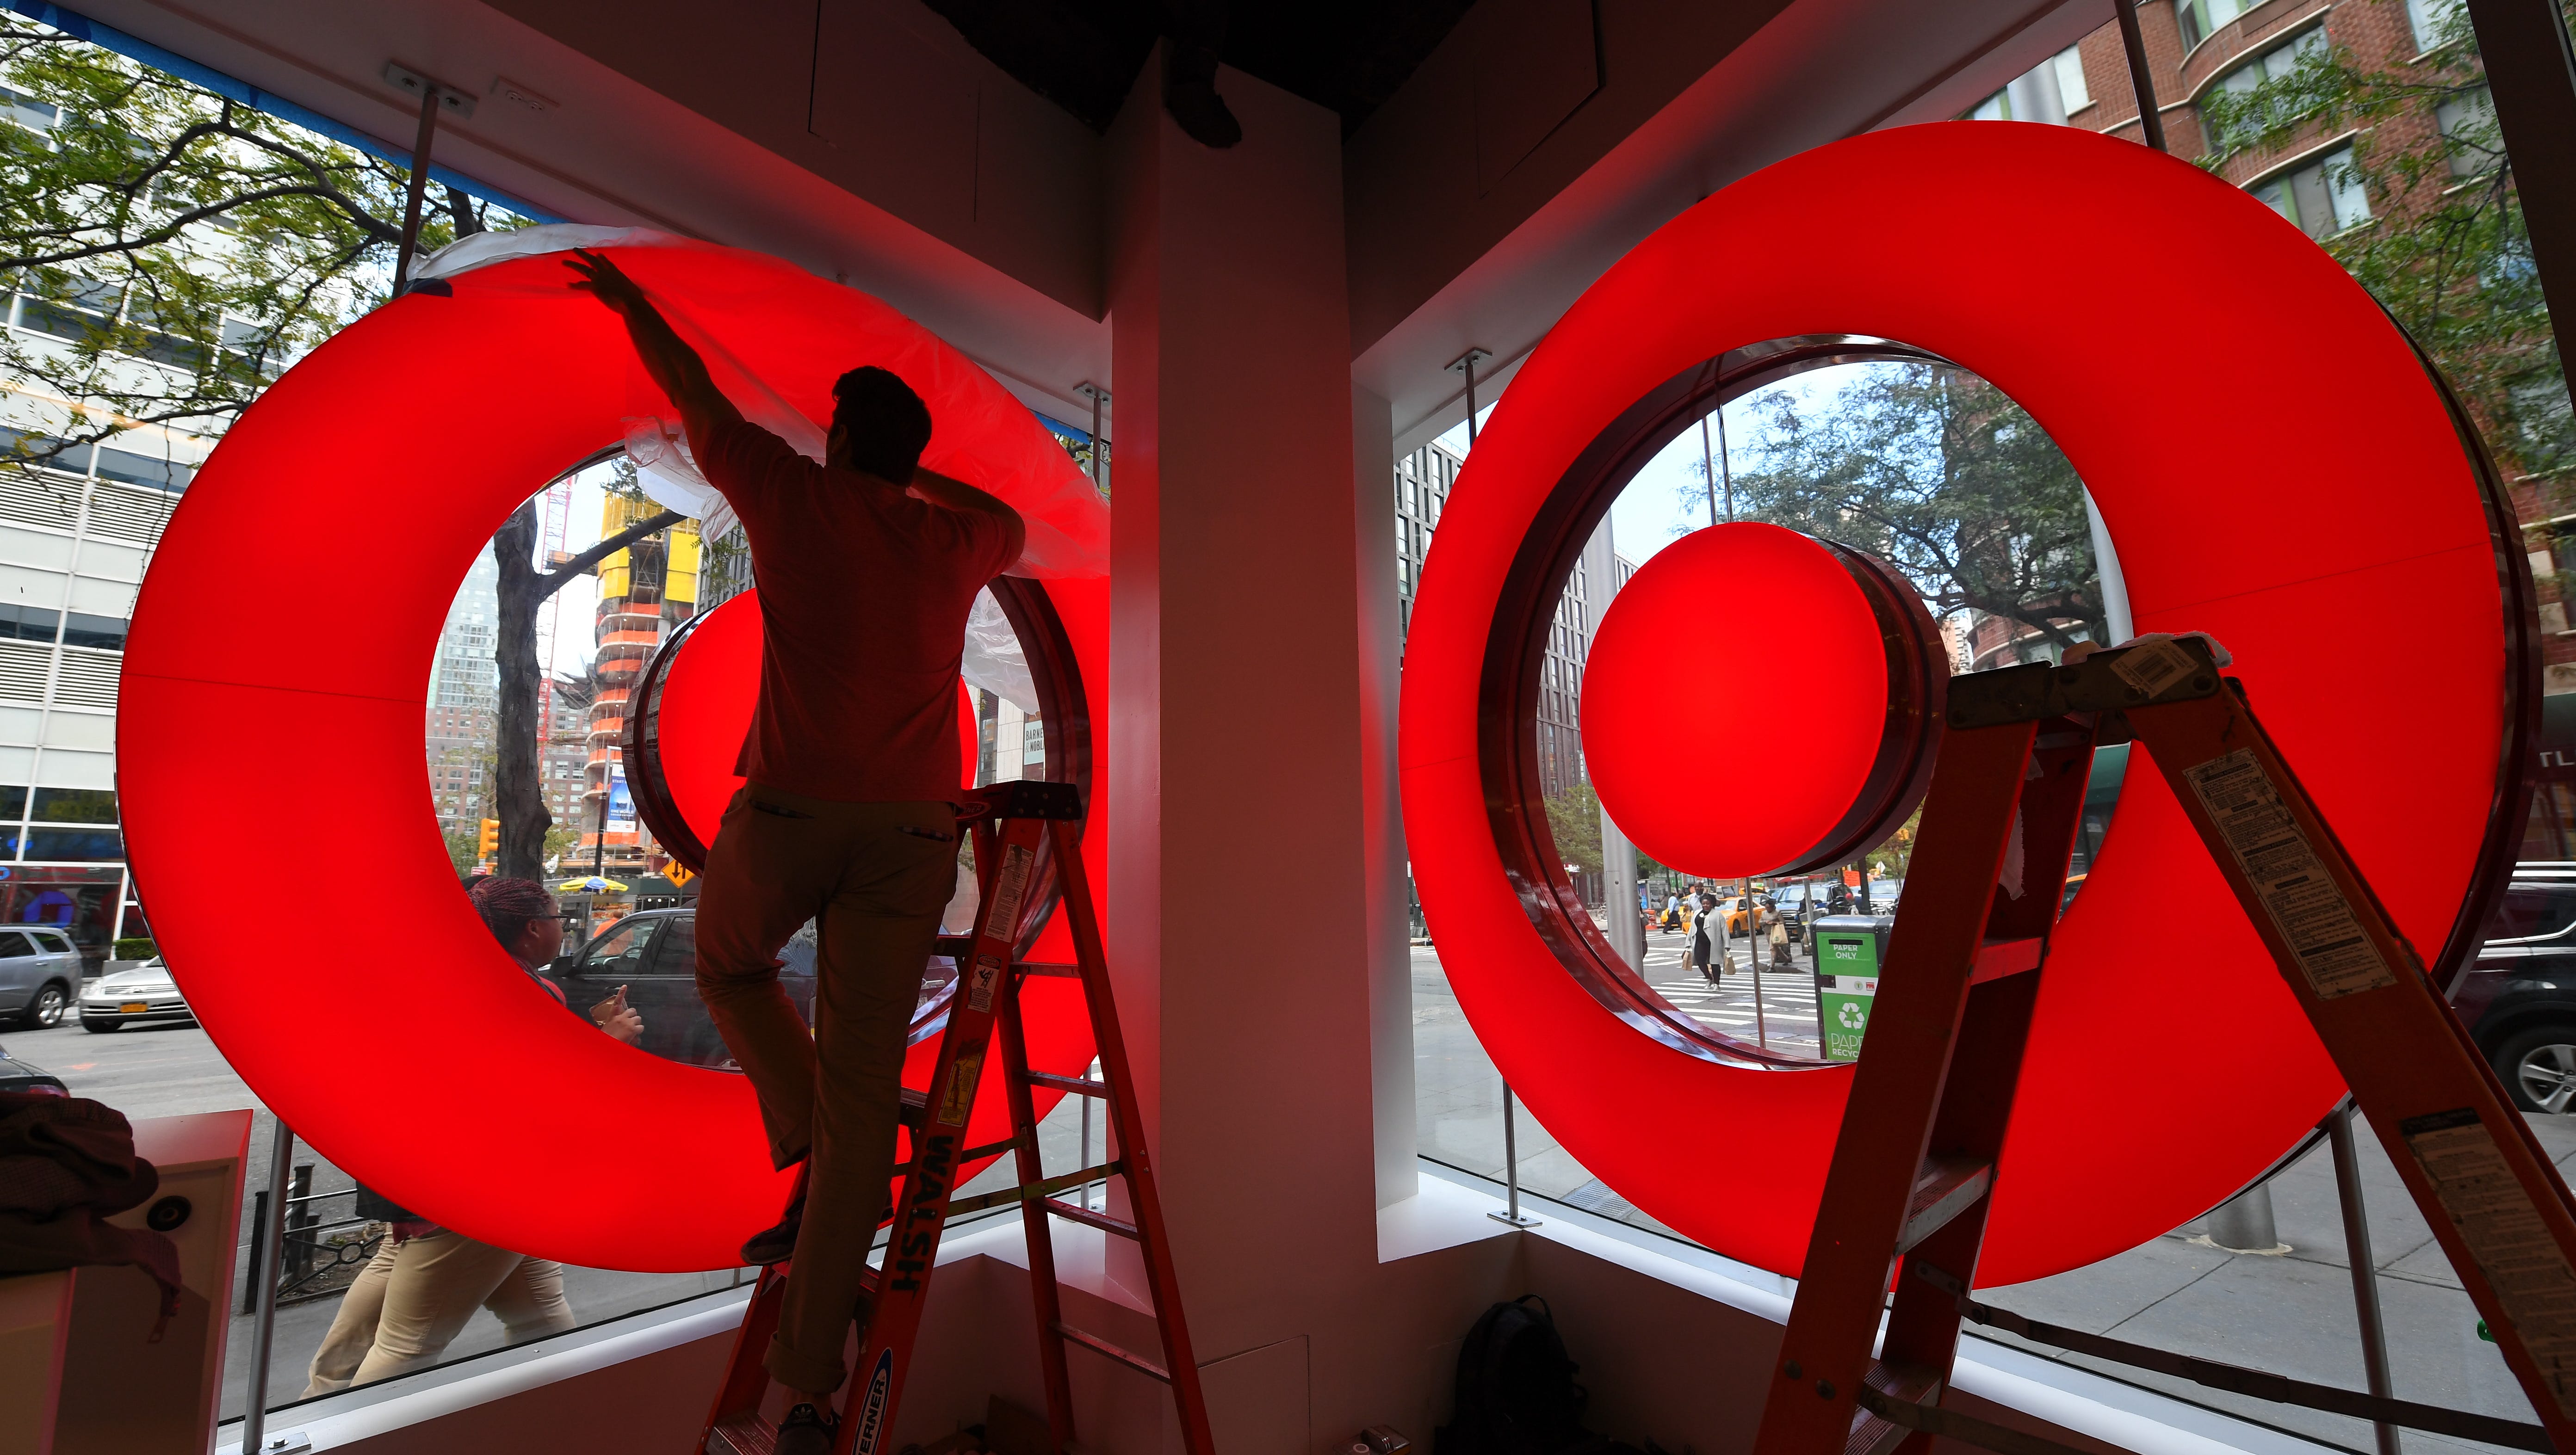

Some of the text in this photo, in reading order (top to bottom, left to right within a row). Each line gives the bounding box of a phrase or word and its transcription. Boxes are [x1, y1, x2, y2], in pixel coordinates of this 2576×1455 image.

[2539, 750, 2576, 768] TL
[1832, 1048, 1860, 1058] RECYC
[891, 1136, 954, 1290] WALSH
[859, 1379, 885, 1455] ERNER
